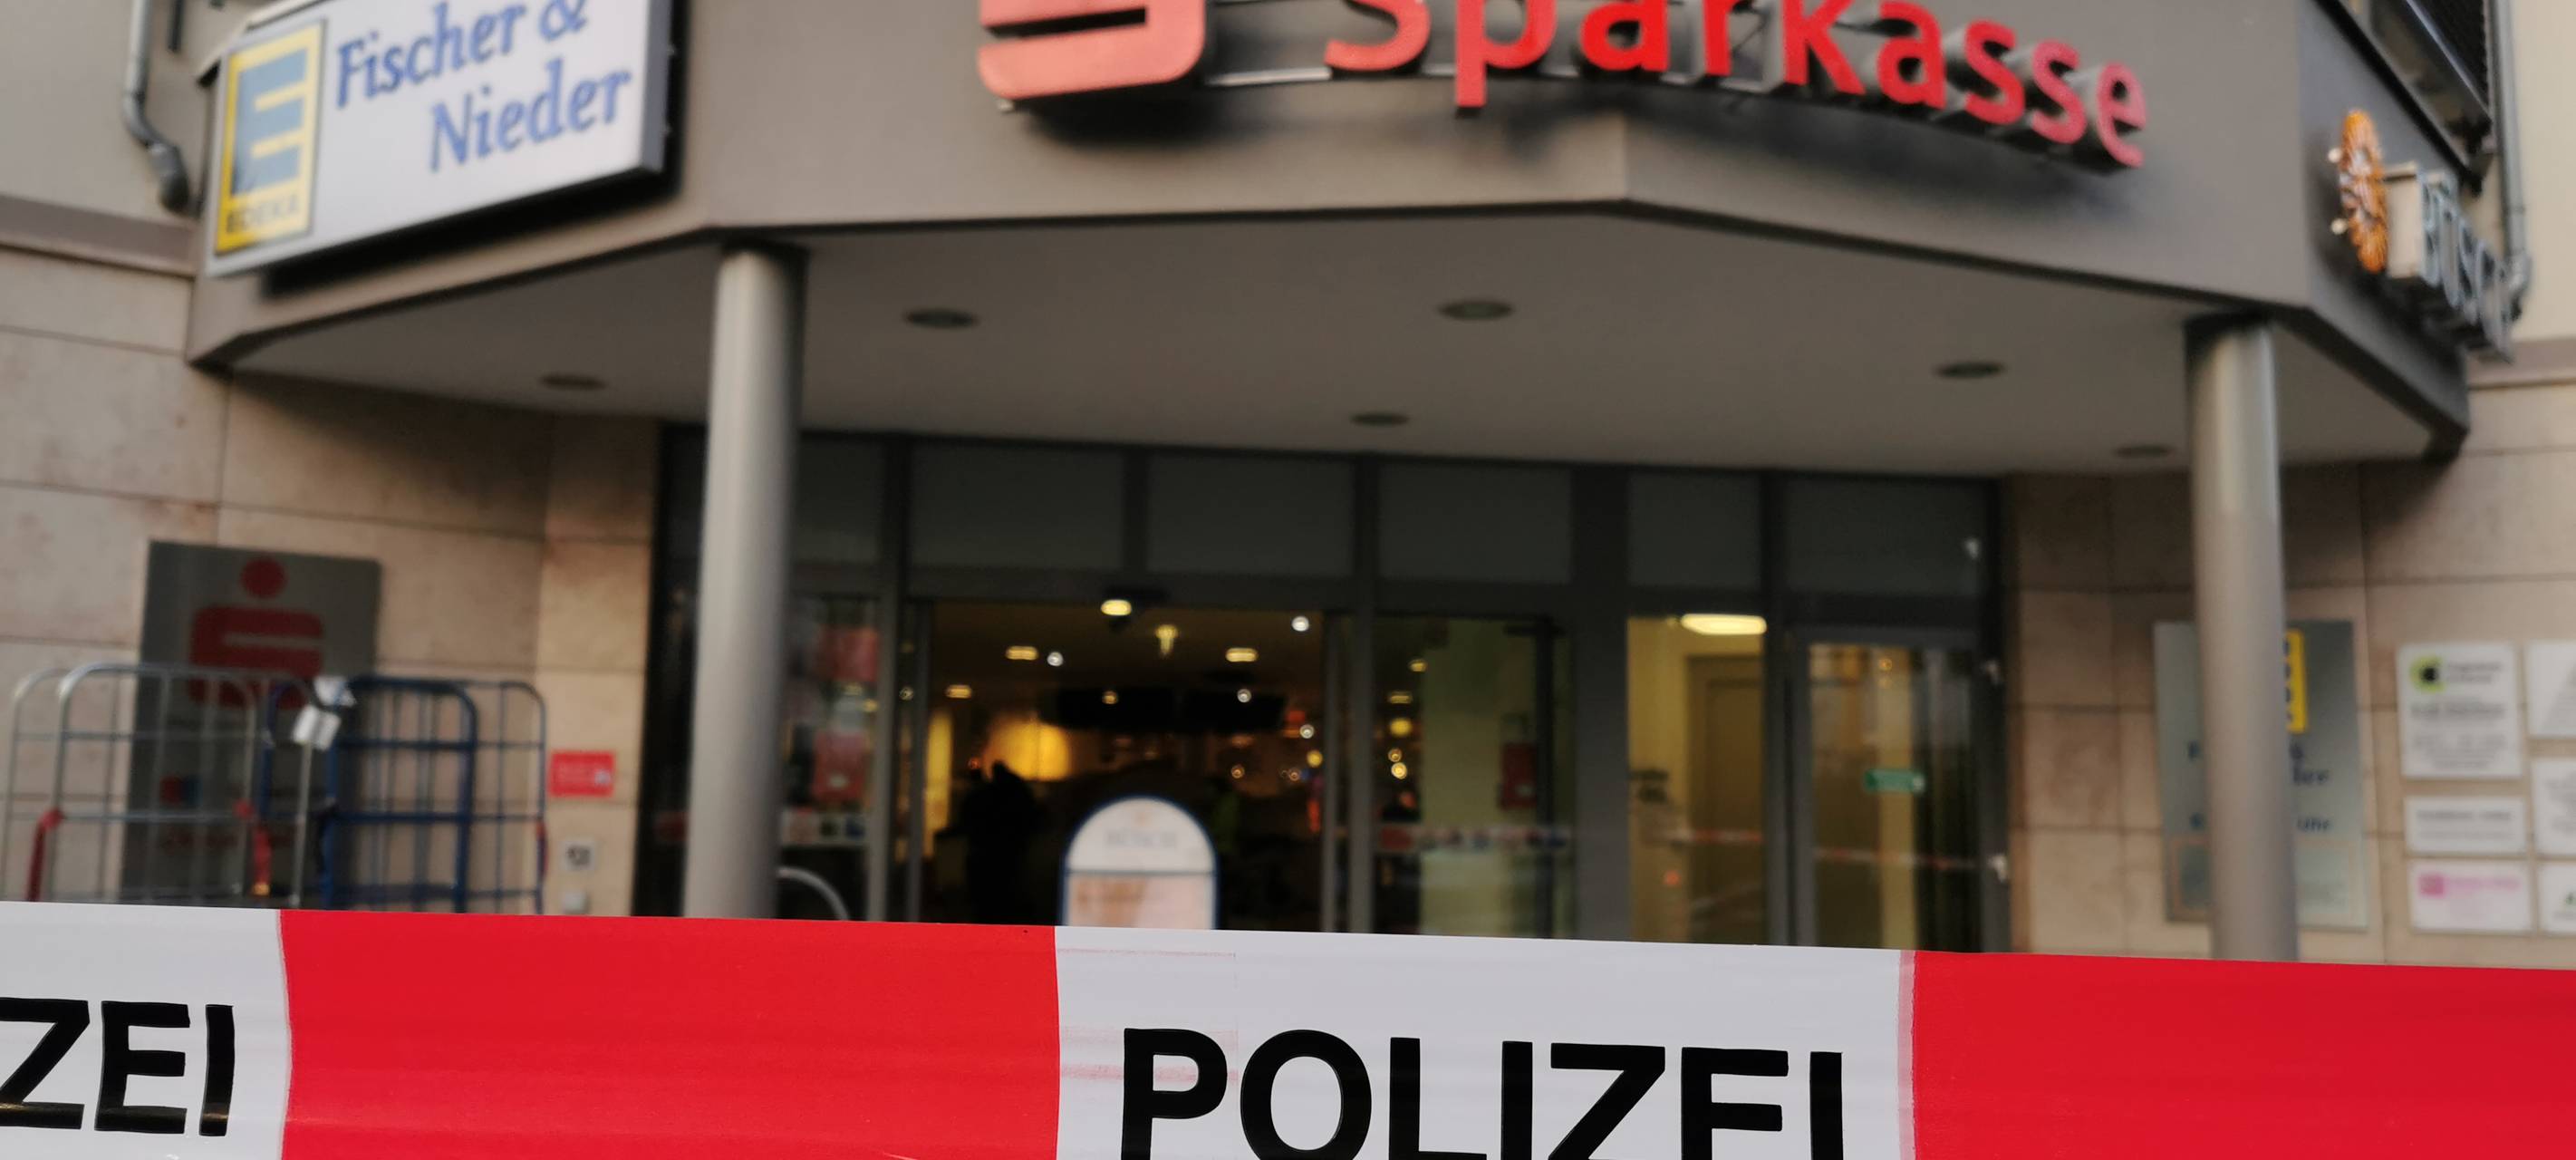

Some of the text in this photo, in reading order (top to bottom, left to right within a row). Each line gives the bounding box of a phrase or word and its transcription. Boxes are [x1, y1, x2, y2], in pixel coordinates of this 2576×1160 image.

[335, 1, 526, 108] Fischer
[429, 58, 632, 173] Nieder
[1121, 1028, 1845, 1160] POLIZEI
